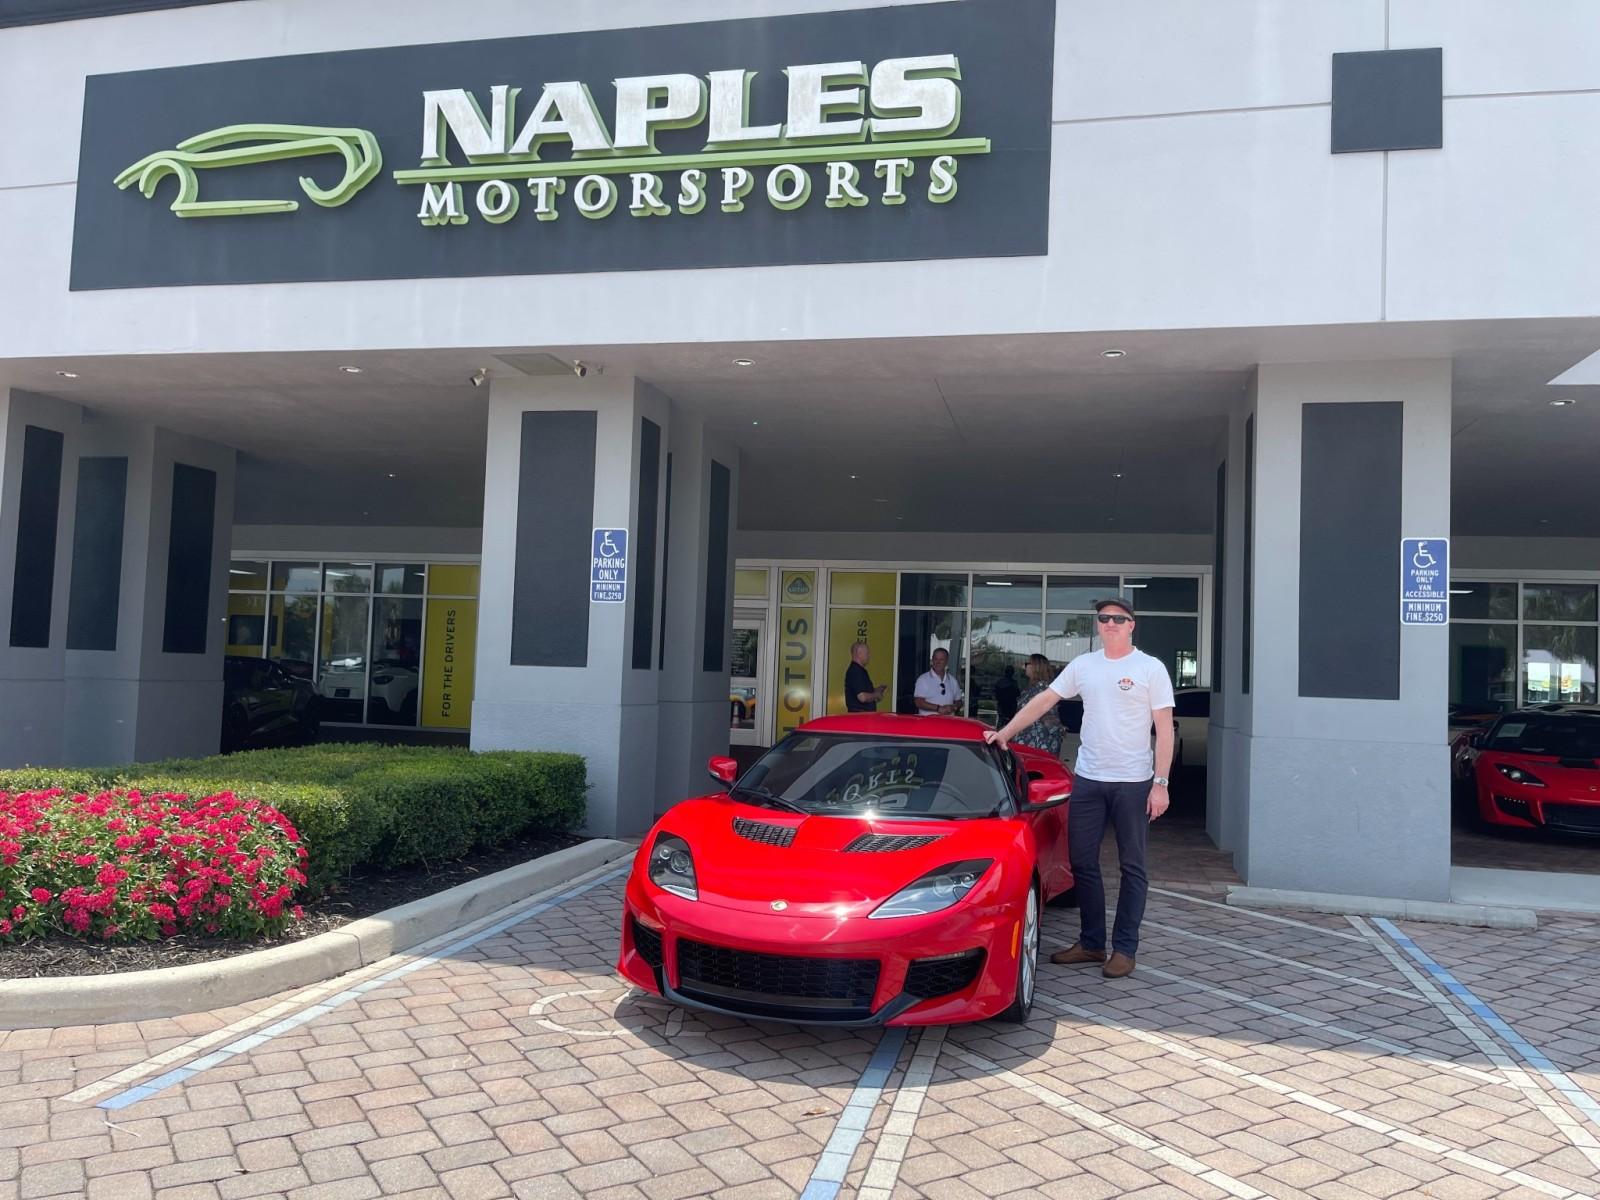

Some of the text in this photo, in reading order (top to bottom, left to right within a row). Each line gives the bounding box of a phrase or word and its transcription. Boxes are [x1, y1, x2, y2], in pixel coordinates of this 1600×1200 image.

[421, 53, 961, 164] NAPLES
[417, 155, 959, 225] MOTORSPORTS
[593, 557, 625, 568] PARKING
[599, 569, 619, 580] ONLY
[595, 583, 621, 591] MINIMUM
[1408, 603, 1441, 611] MINIMUM
[442, 609, 457, 717] FOR THE DRIVERS
